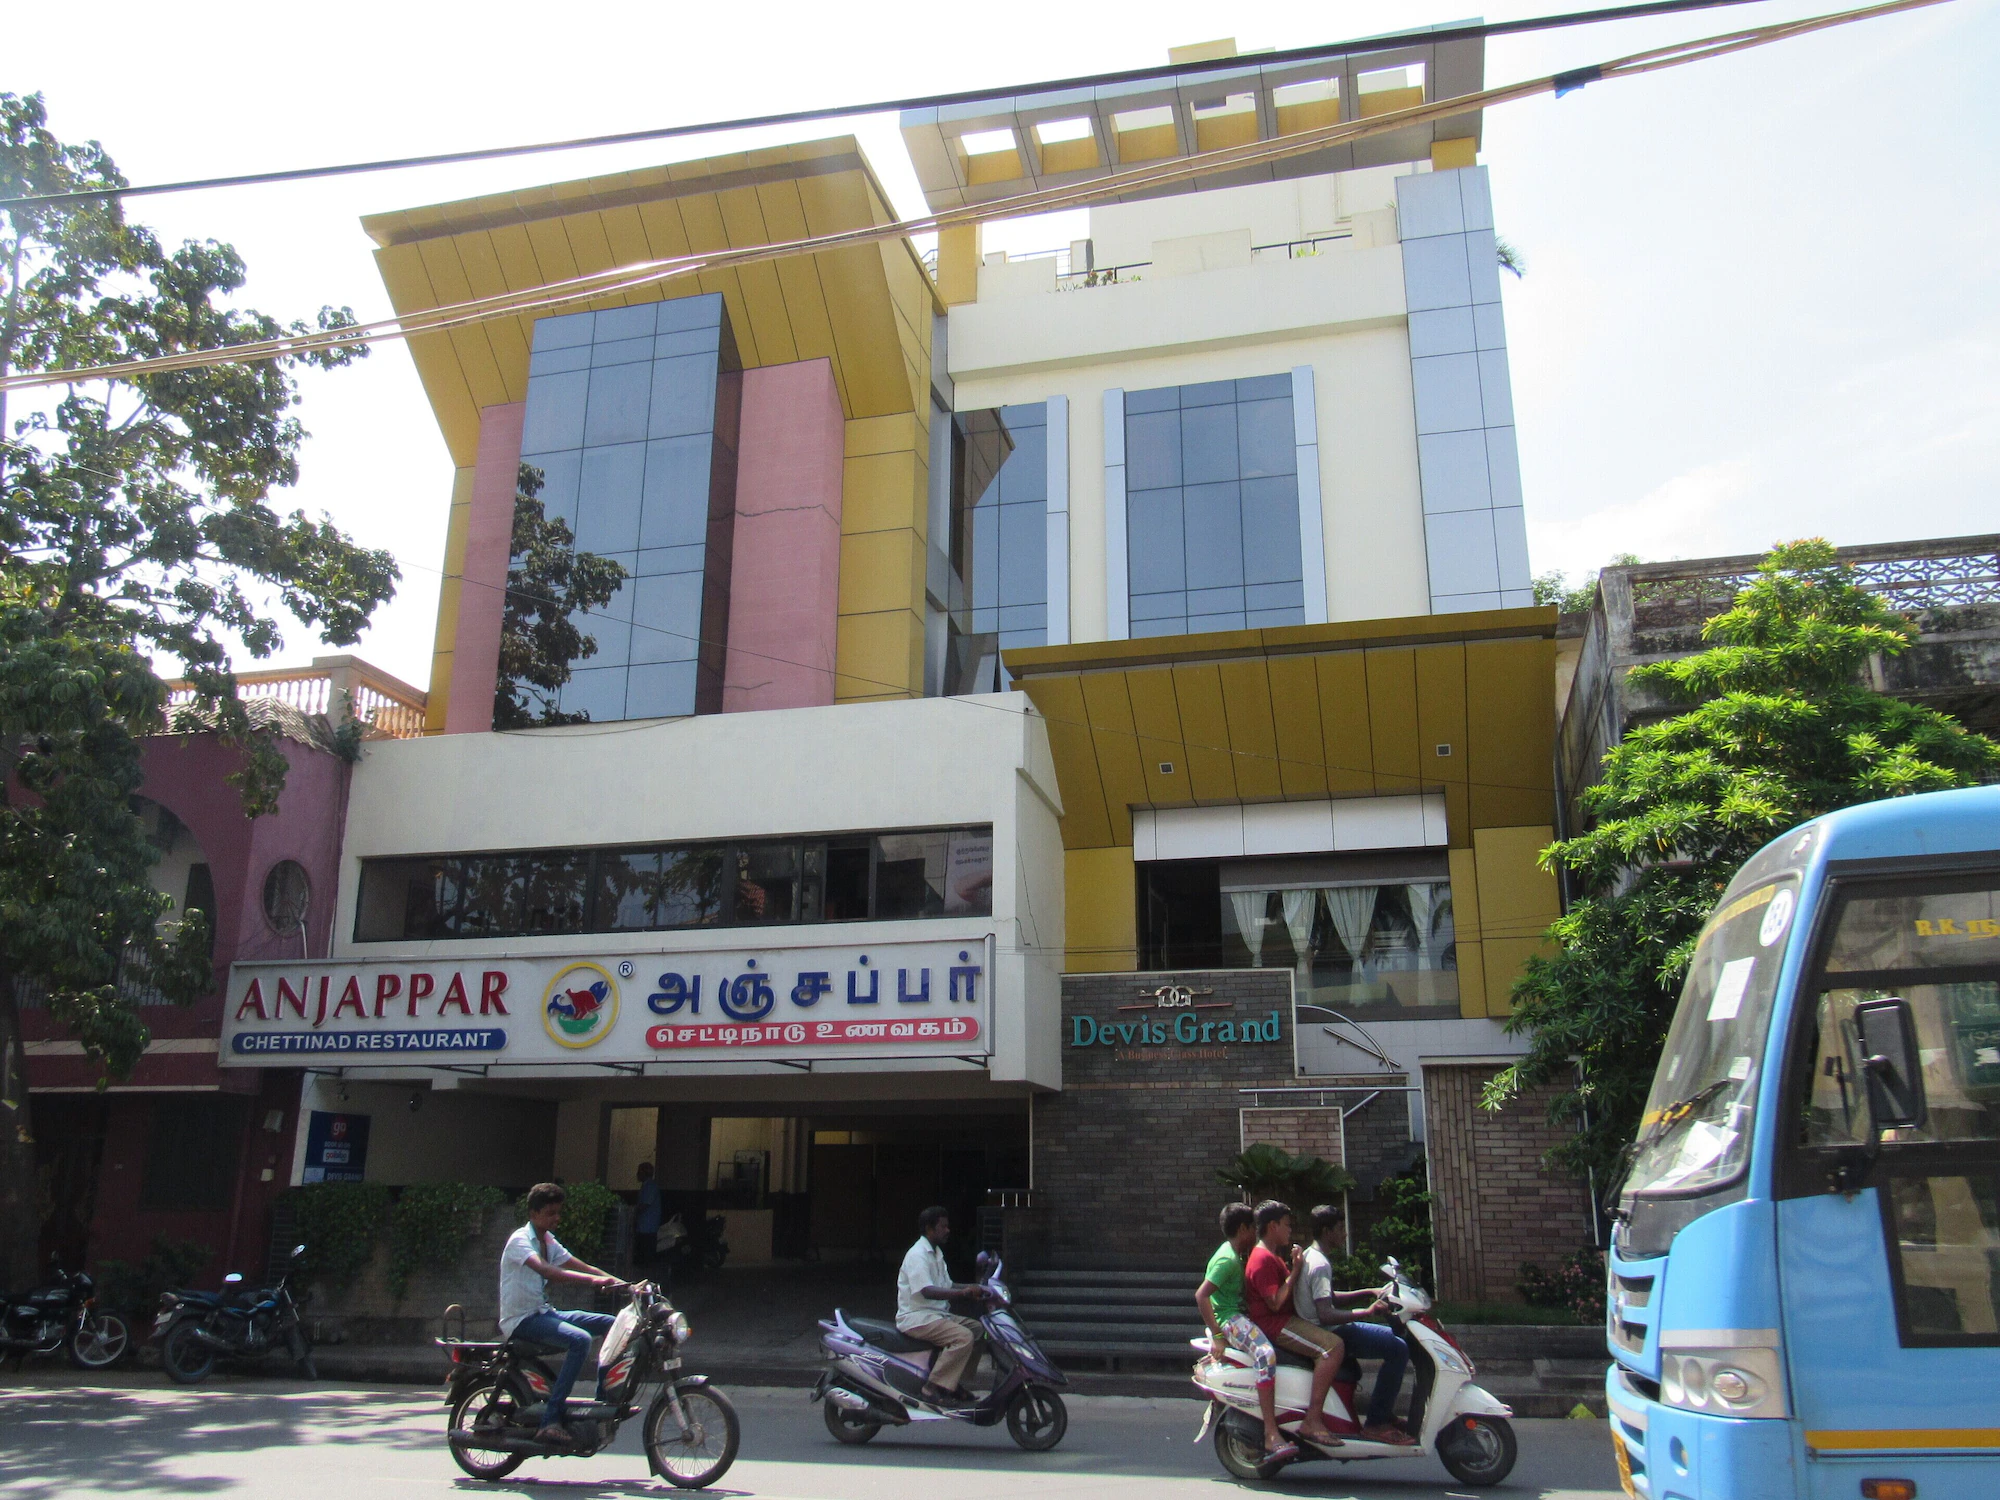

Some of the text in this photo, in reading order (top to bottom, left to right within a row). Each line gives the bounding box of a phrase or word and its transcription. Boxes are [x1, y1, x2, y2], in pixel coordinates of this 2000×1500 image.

[235, 970, 511, 1028] ANJAPPAR
[647, 950, 983, 1022] அஞ்சப்பர்
[242, 1032, 492, 1051] CHETTINAD RESTAURANT
[655, 1018, 967, 1046] செட்டிநாடு உணவகம்
[1071, 1010, 1281, 1047] Devis Grand
[1199, 1048, 1226, 1059] Hotel
[333, 1122, 347, 1136] go
